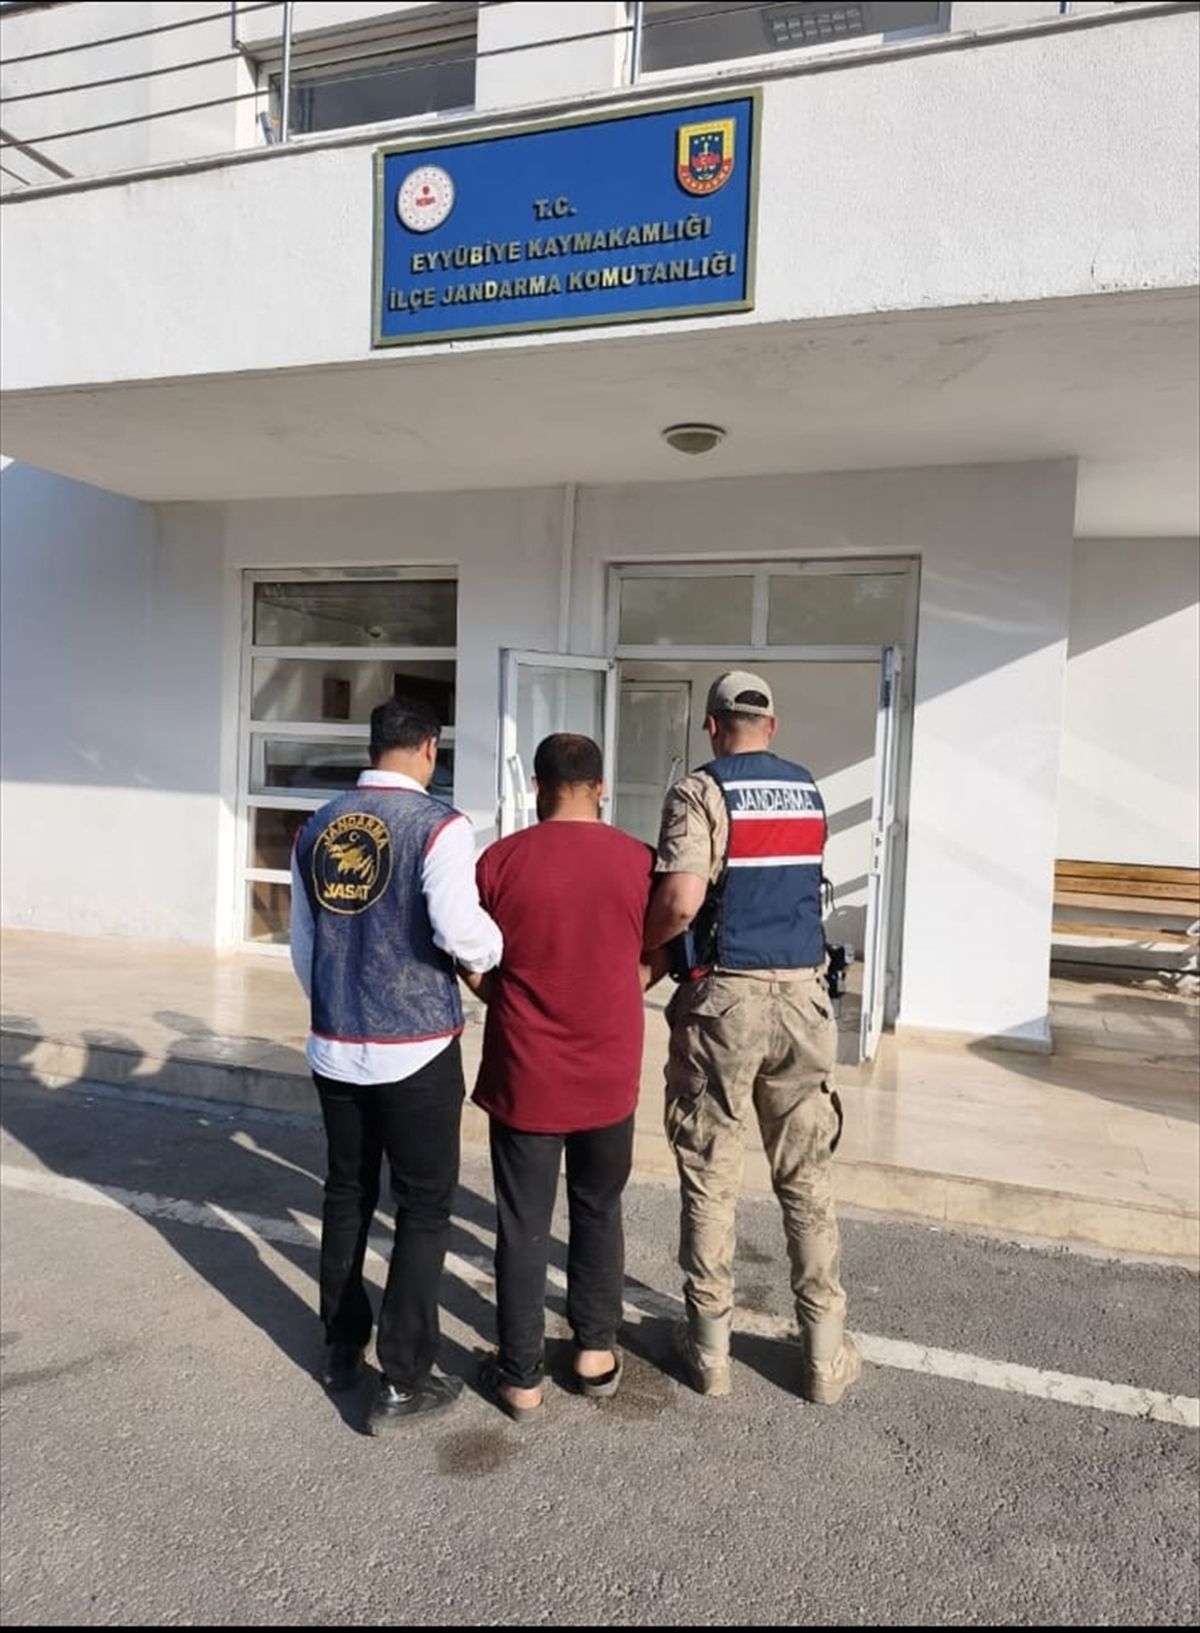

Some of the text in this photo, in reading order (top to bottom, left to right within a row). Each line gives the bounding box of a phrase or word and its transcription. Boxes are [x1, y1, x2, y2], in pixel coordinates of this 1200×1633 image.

[536, 198, 576, 218] T.C.
[412, 215, 711, 272] EYYÜBİYE KAYMAKAMLIĞI
[389, 252, 737, 314] İLÇE JANDARMA KOMUTANLIĞI
[736, 788, 814, 810] JANDARMA
[323, 815, 388, 850] JANDARMA
[323, 884, 371, 900] JASAT
